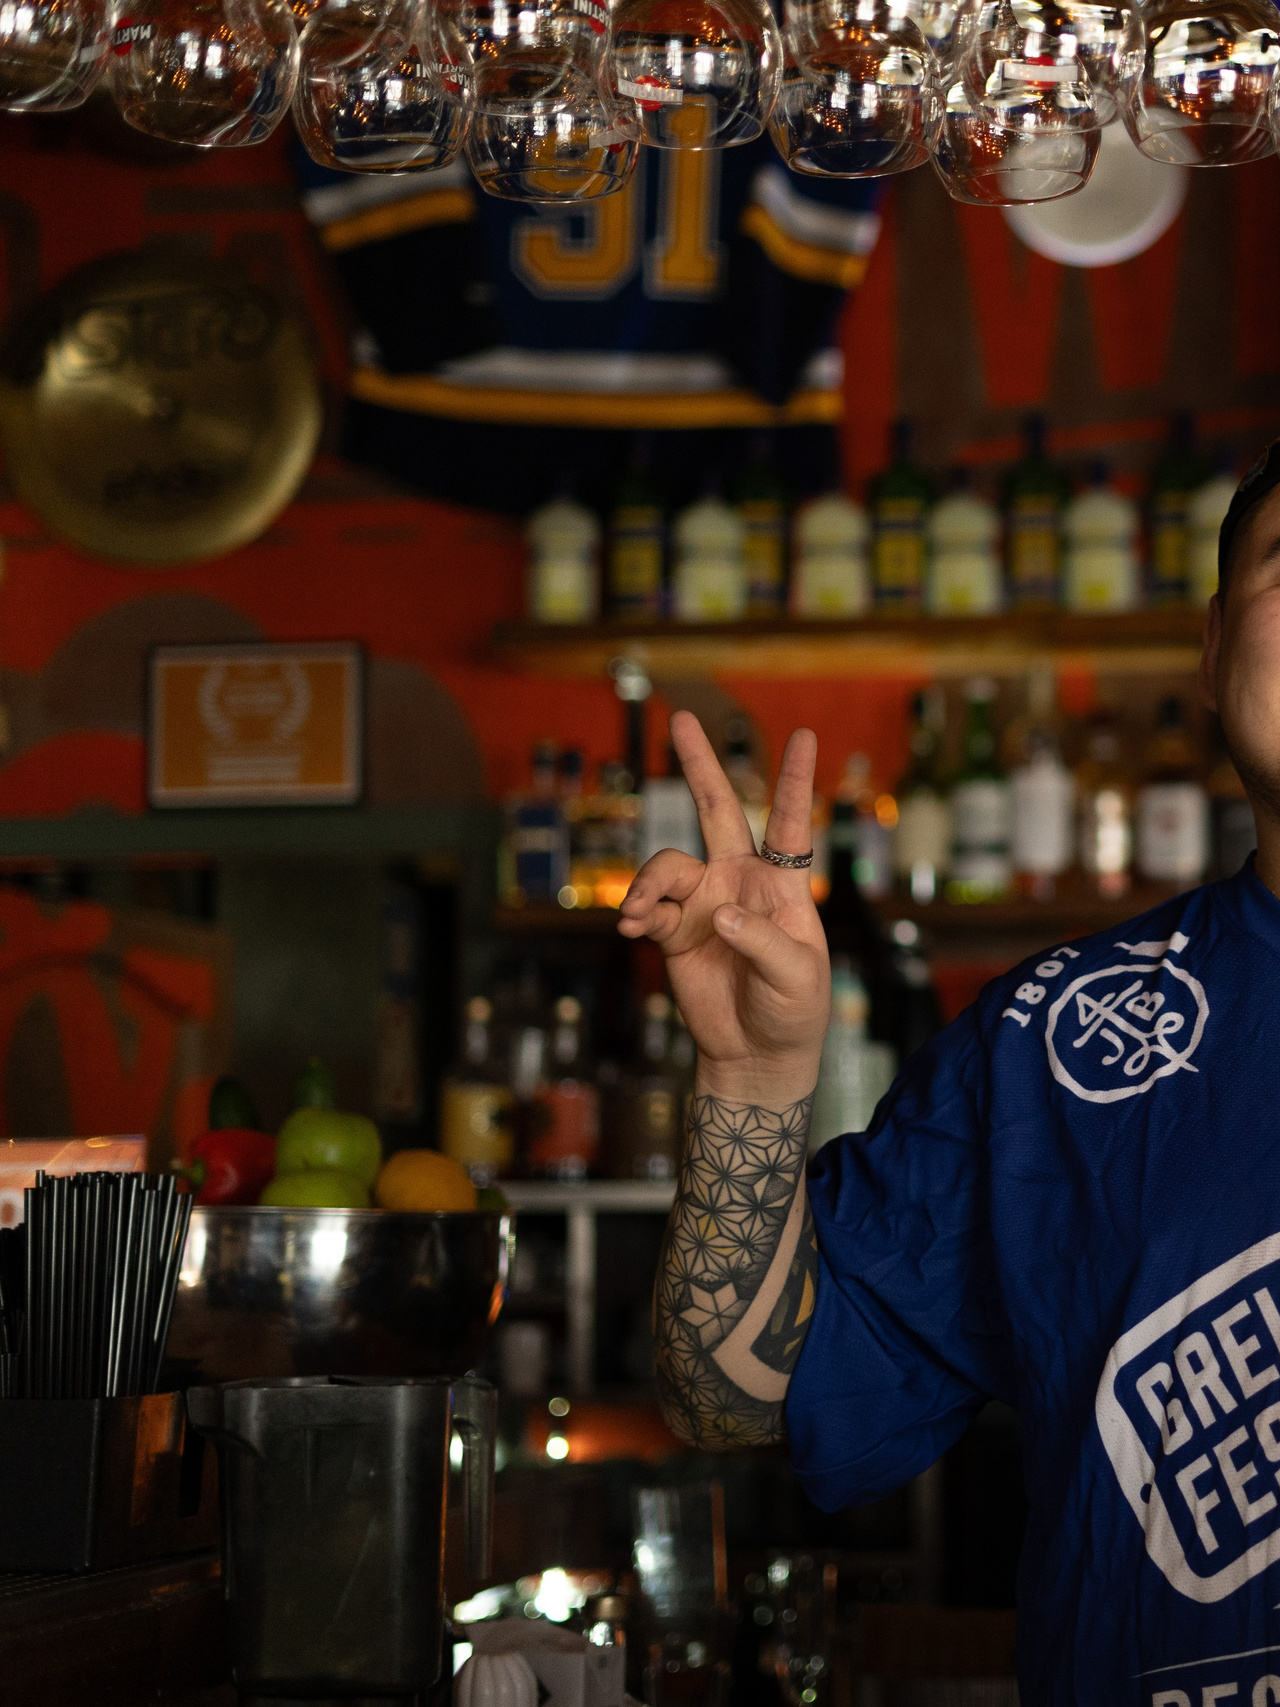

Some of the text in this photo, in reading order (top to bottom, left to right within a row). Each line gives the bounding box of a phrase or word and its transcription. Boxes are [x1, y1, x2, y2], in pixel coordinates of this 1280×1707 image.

[573, 0, 612, 27] ARTINI
[114, 24, 152, 46] MART
[1002, 946, 1081, 1028] 1807
